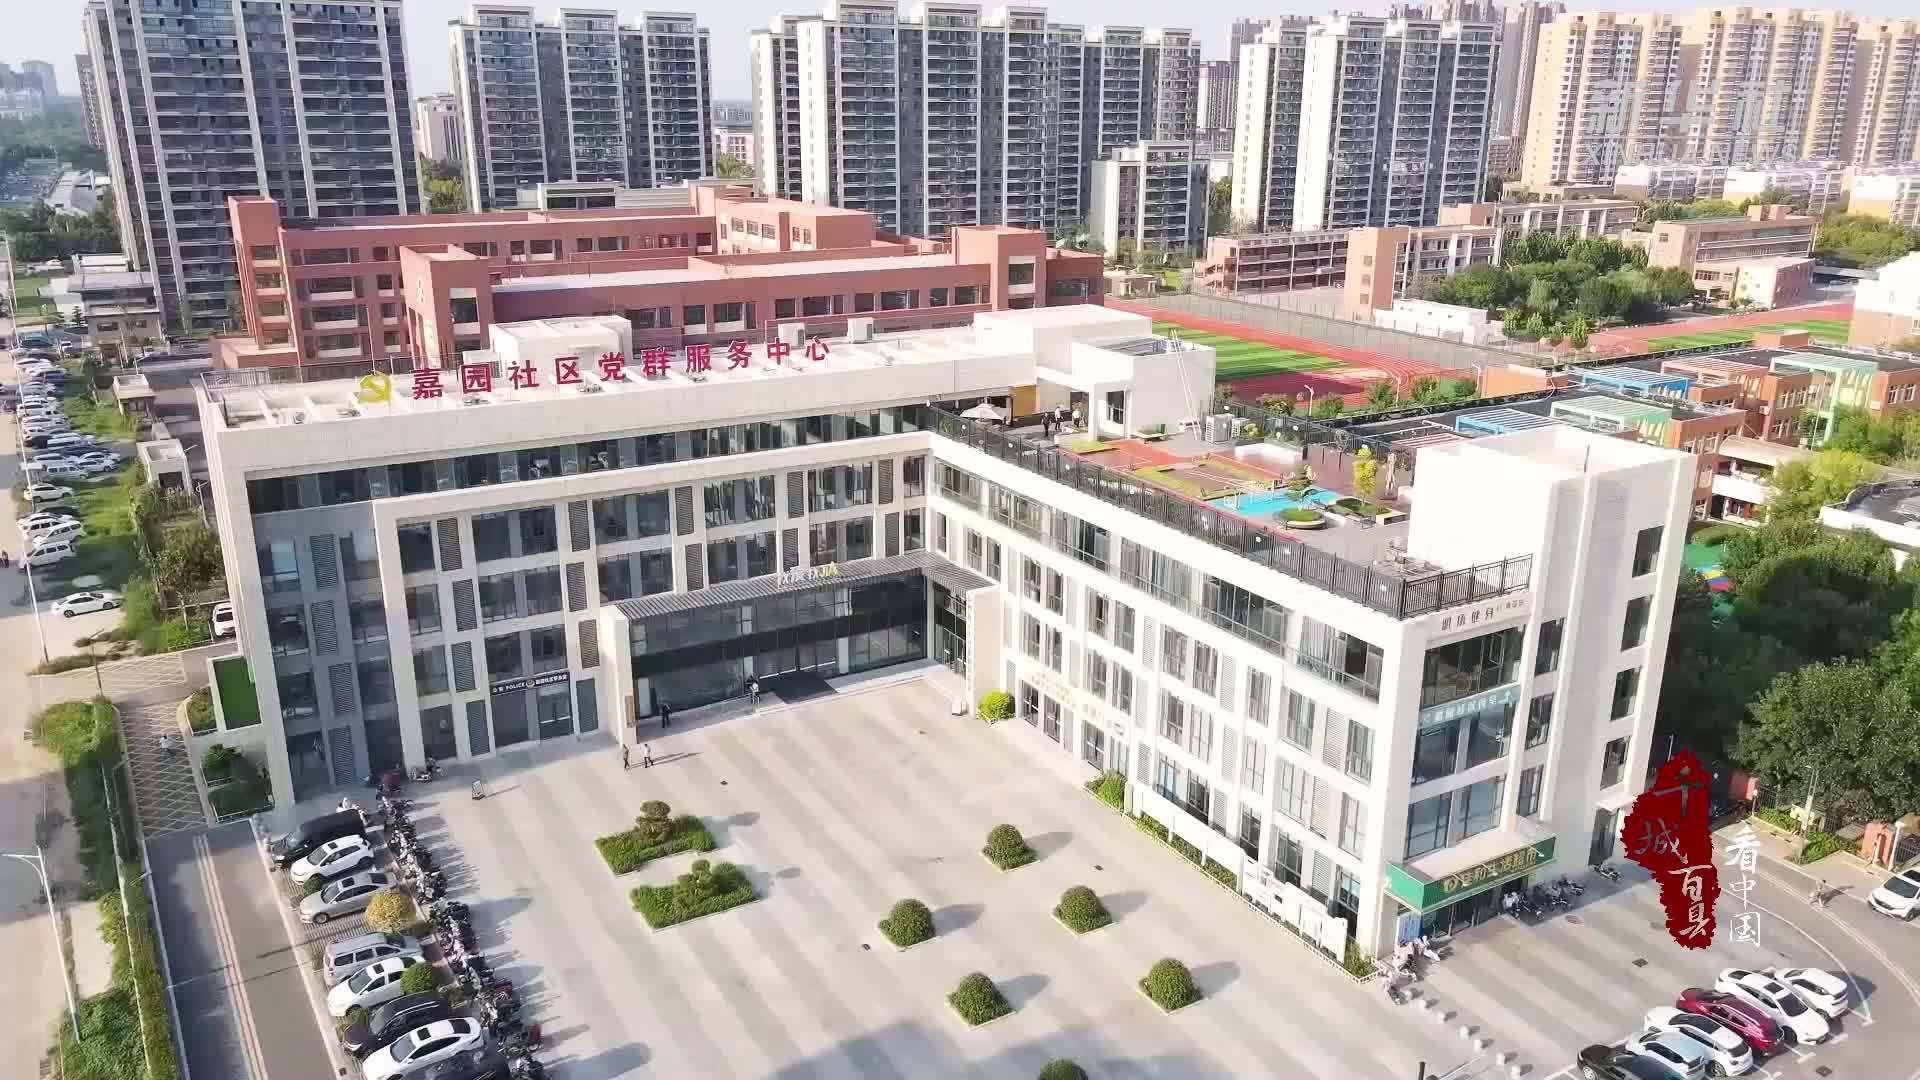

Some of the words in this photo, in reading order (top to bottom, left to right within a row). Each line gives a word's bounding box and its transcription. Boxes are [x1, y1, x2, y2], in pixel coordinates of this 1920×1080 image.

[411, 336, 830, 399] 嘉园社区党群服务中心
[505, 682, 525, 690] POLICE
